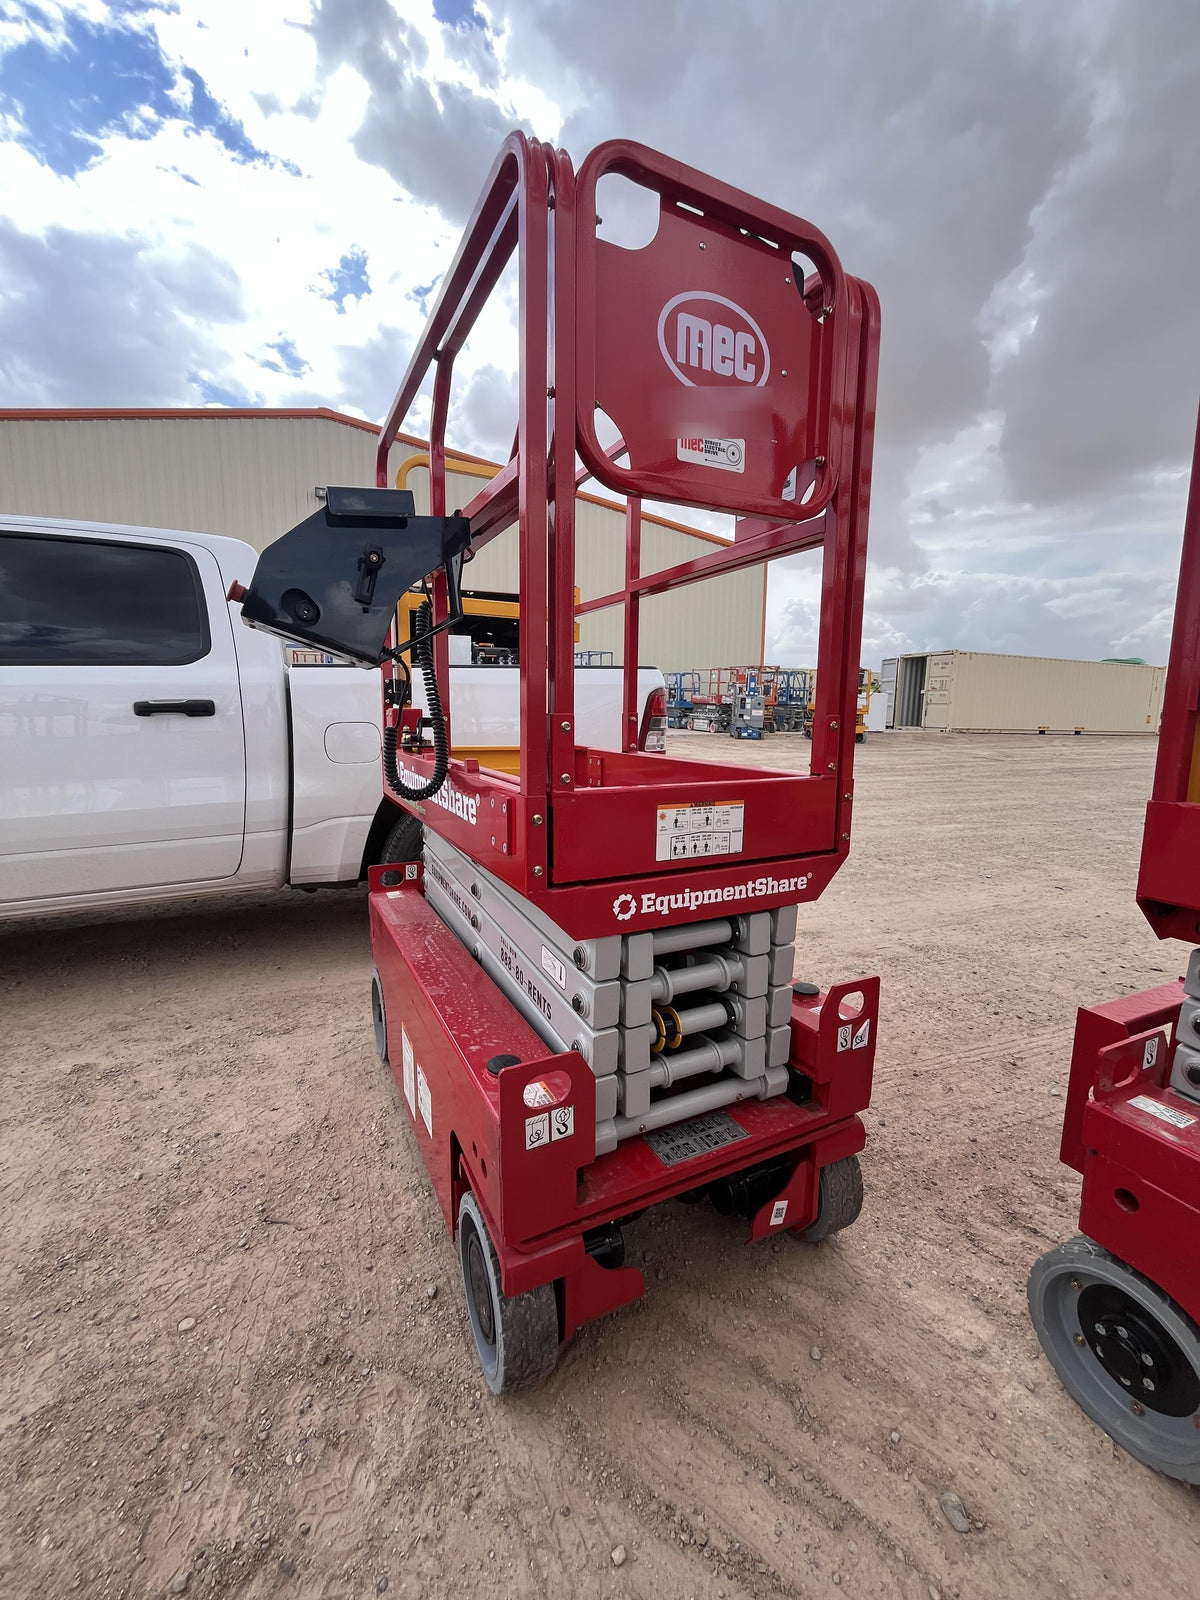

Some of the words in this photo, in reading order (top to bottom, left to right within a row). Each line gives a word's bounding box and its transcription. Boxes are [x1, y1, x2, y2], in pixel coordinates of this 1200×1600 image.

[704, 439, 722, 447] DIRECT
[704, 444, 727, 454] ELECTRIC
[704, 449, 719, 457] DRIVE
[500, 947, 552, 1020] 888-80-RENTS
